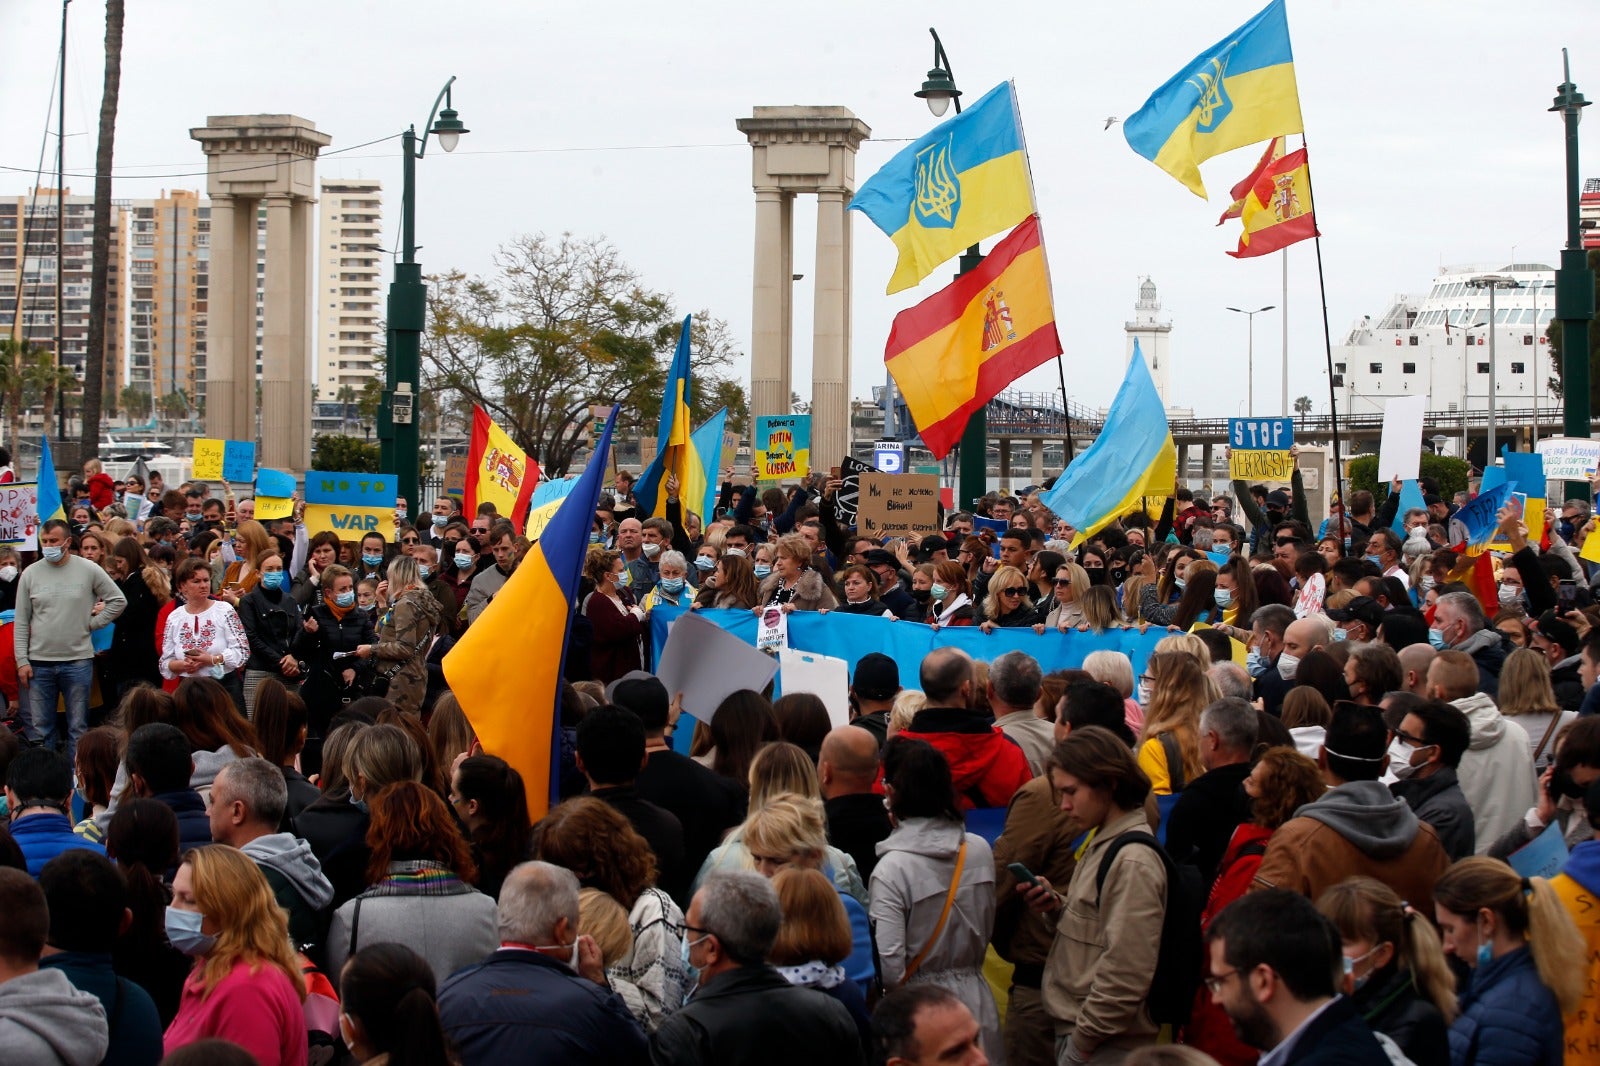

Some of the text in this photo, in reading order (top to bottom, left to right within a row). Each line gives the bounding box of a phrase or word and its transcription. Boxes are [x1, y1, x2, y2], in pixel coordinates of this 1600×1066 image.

[769, 432, 792, 446] PUTIN
[1234, 421, 1283, 447] STOP
[766, 461, 796, 475] GUERRA
[878, 453, 900, 472] P
[320, 479, 386, 493] NO TO
[330, 513, 380, 531] WAR
